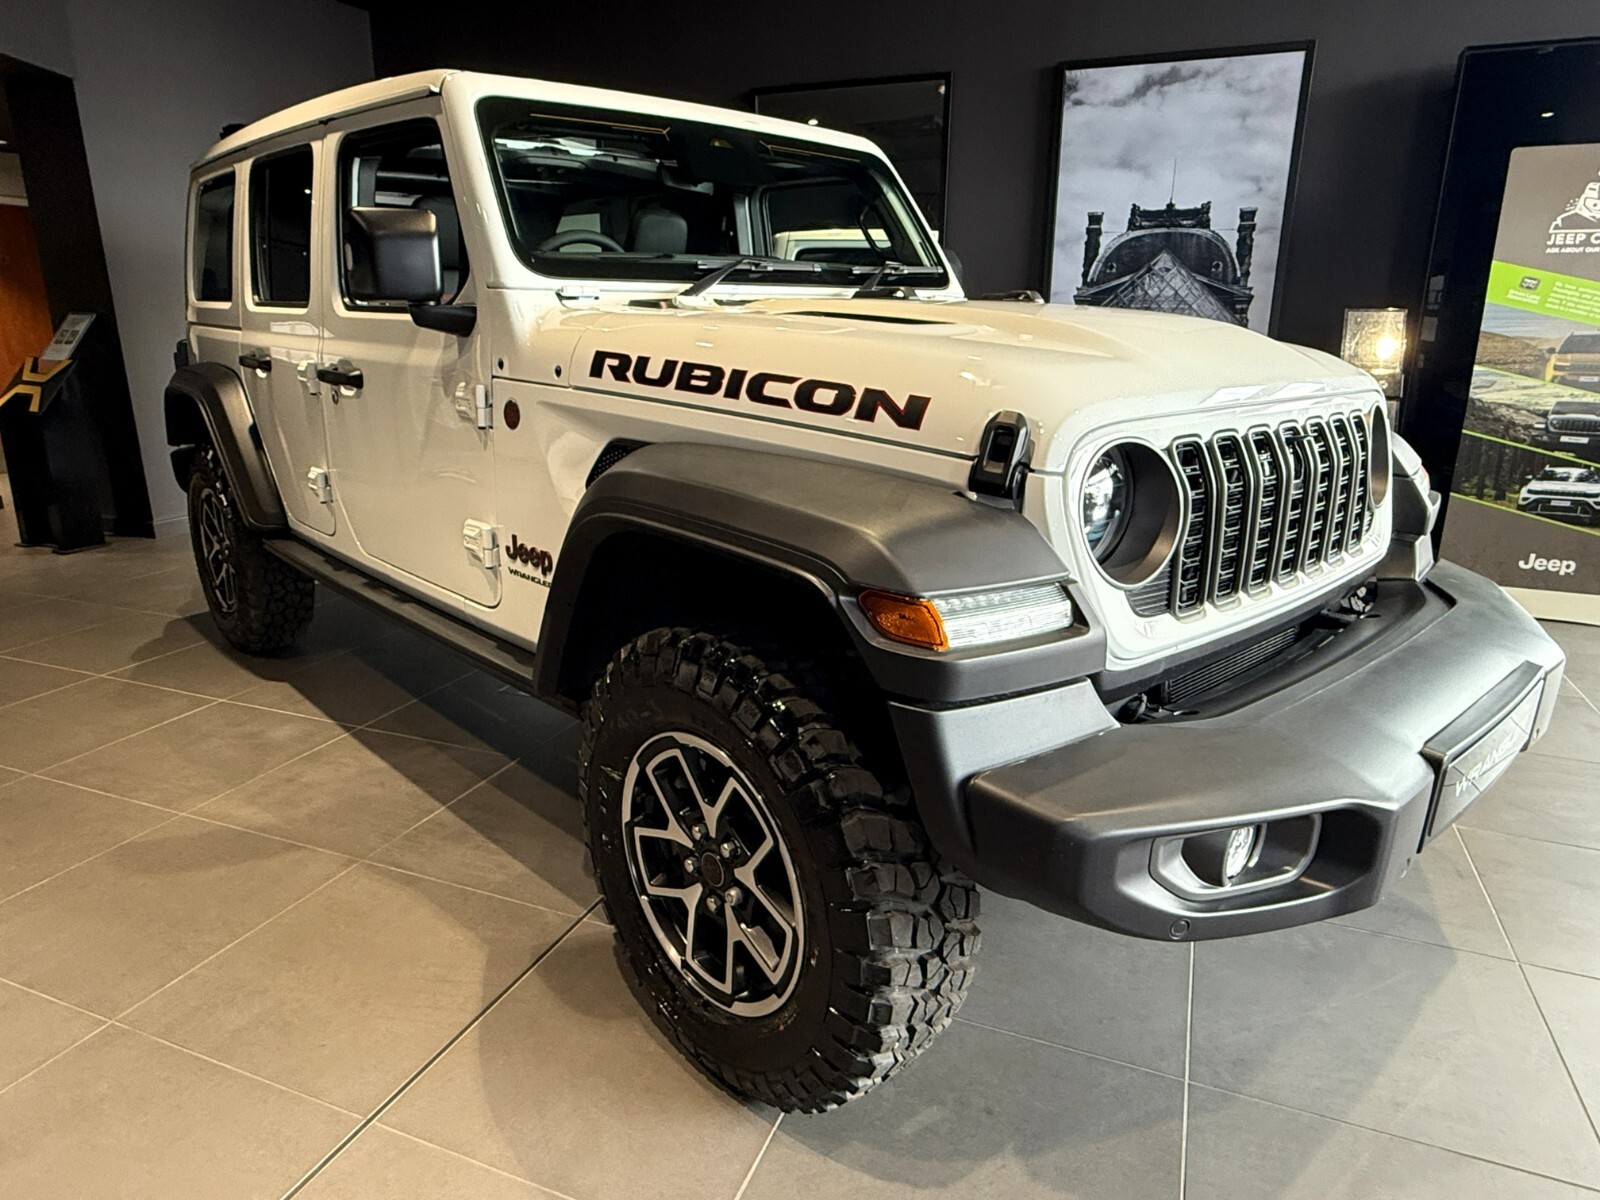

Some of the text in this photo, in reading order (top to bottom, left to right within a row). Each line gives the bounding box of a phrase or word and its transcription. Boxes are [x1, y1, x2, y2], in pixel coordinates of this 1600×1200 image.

[1546, 233, 1586, 246] JEEP
[1560, 246, 1584, 254] ABOUT
[589, 350, 932, 431] RUBICON
[505, 534, 553, 577] Jeep
[1518, 553, 1576, 576] Jeep
